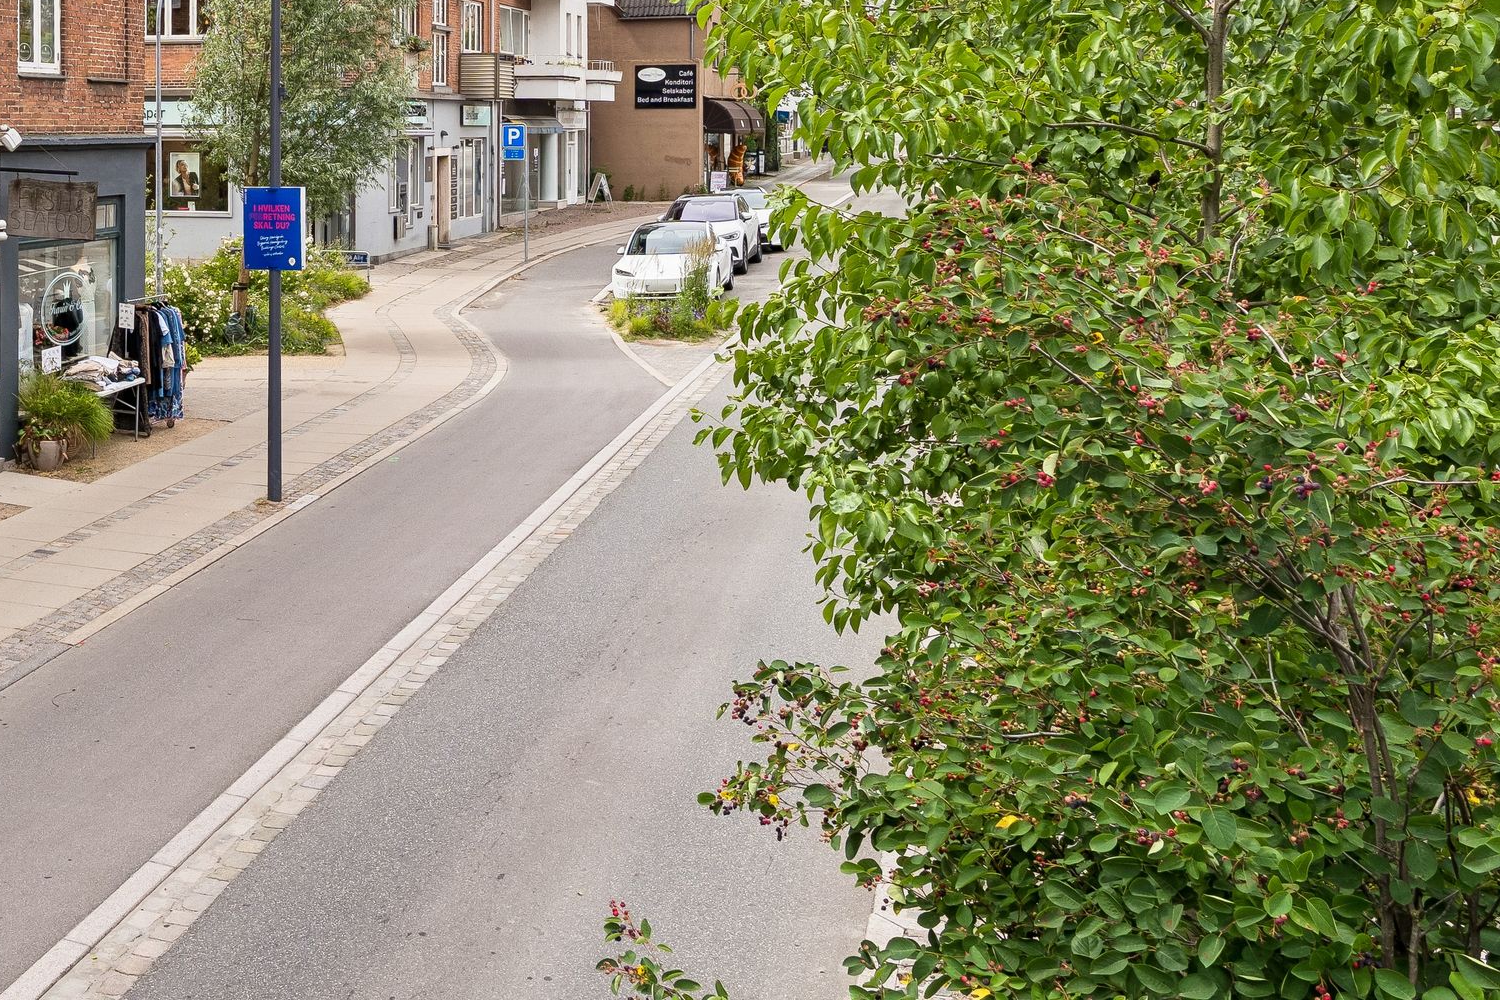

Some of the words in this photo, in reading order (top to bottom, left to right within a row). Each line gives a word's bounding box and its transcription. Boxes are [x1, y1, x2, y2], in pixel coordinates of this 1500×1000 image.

[508, 128, 521, 145] P
[258, 204, 291, 212] HVILKEN
[10, 209, 93, 234] SEAFOOD
[253, 221, 274, 229] SKAL
[276, 221, 290, 229] DU?
